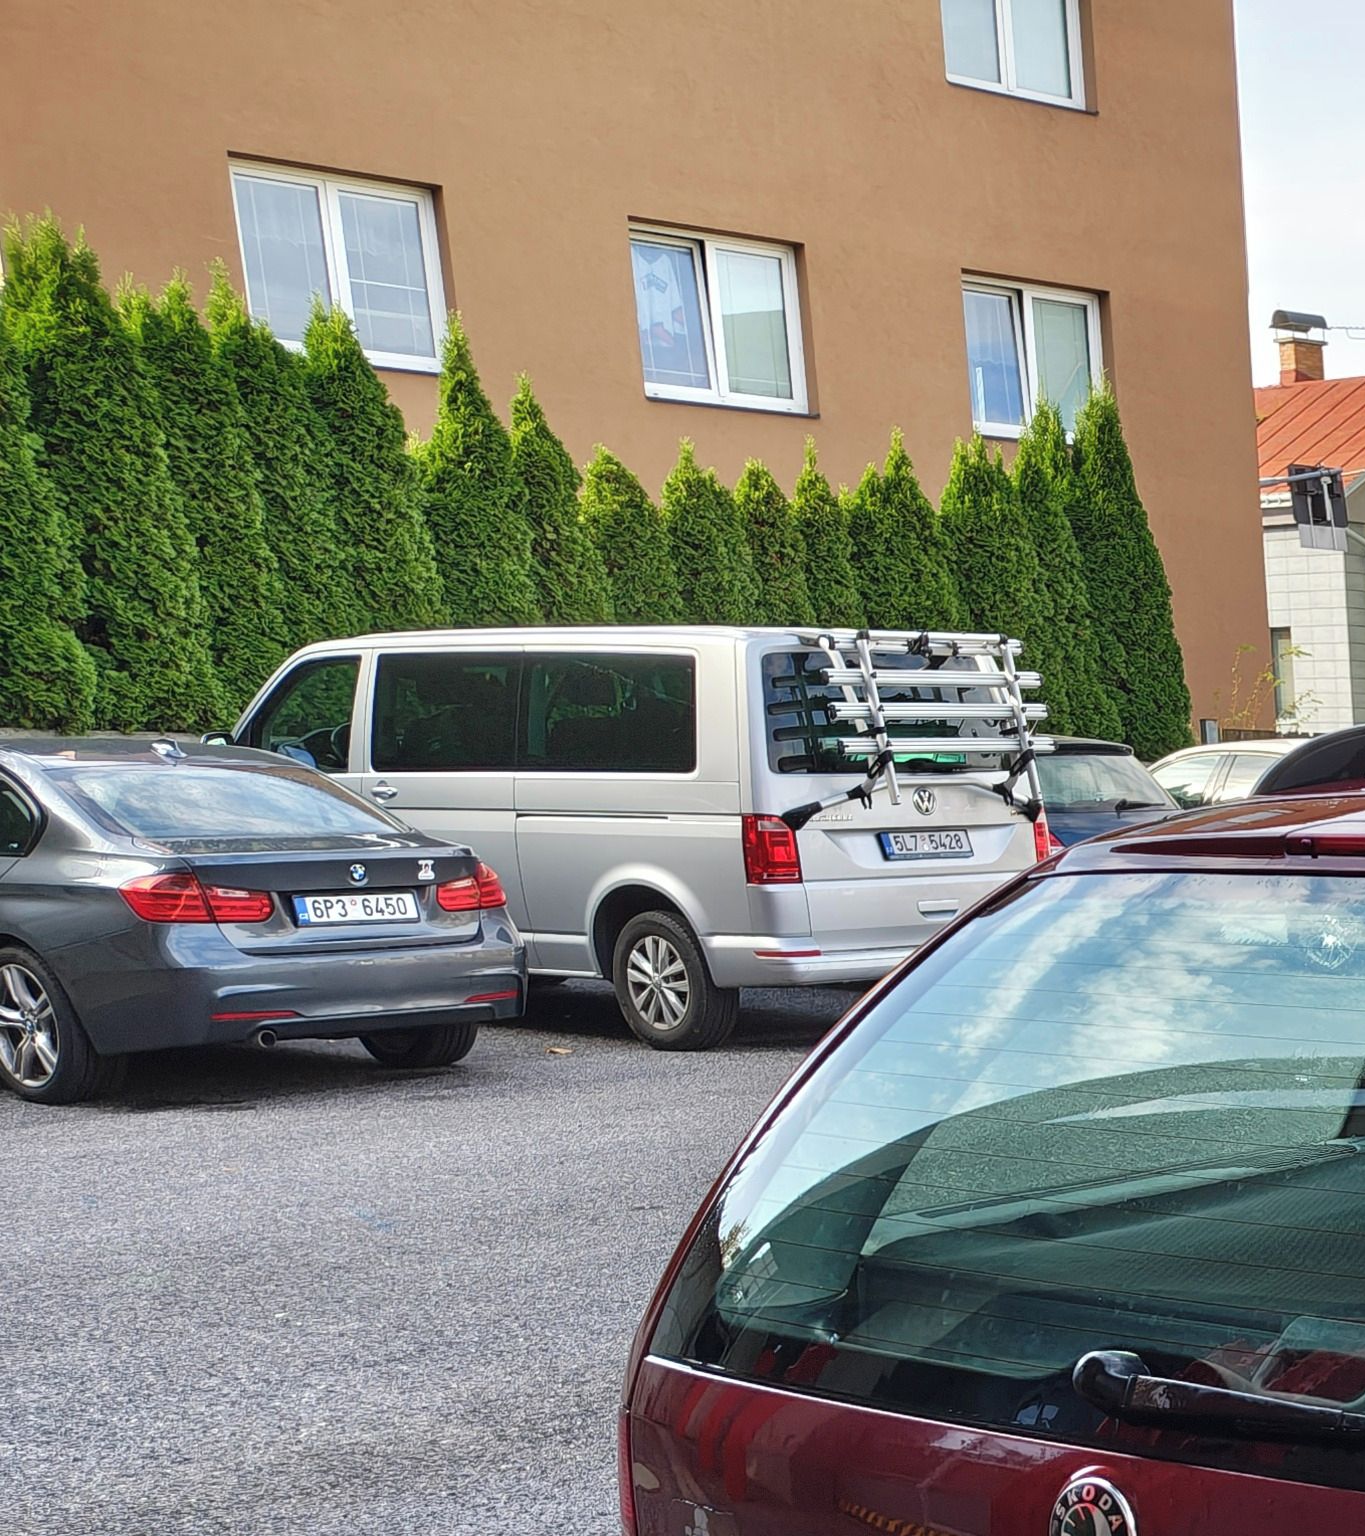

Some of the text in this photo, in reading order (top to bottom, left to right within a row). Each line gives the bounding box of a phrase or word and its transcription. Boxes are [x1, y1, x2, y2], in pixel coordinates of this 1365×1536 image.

[892, 834, 918, 852] 5L7
[927, 833, 964, 850] 5428
[312, 899, 349, 919] 6P3
[361, 897, 408, 917] 6450
